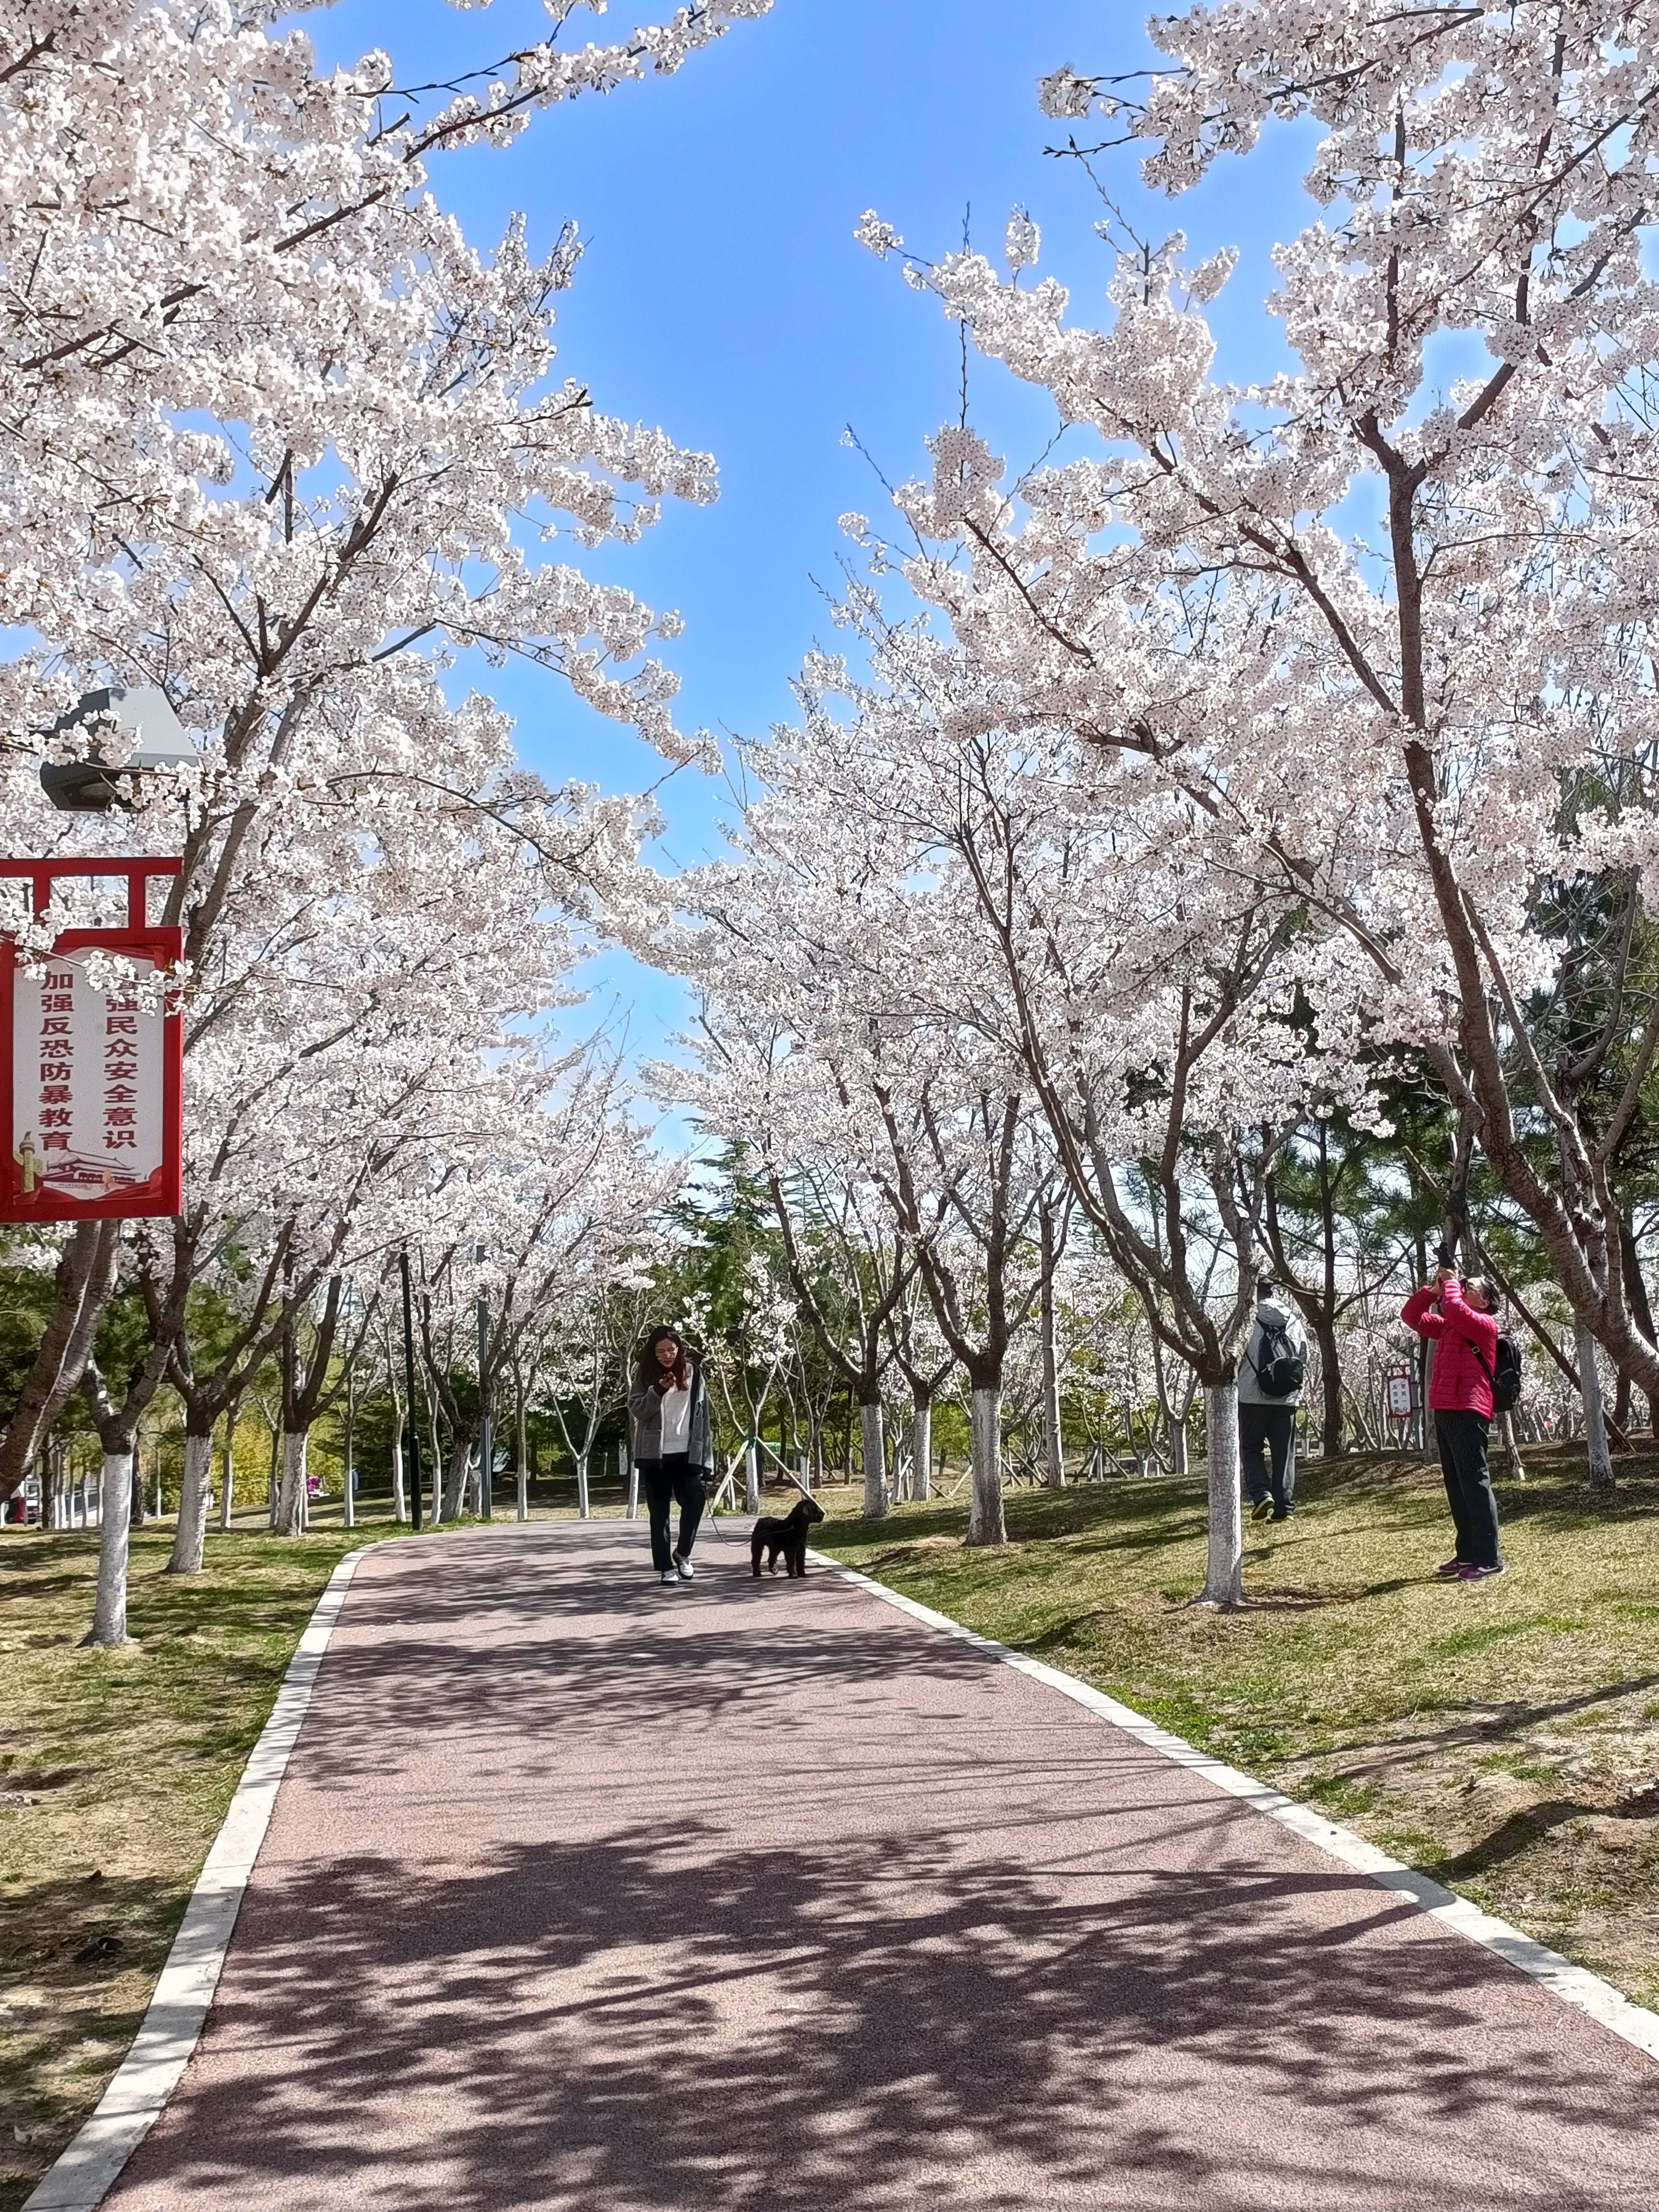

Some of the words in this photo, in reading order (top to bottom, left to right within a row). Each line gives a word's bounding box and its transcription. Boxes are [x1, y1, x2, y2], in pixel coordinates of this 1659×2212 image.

[39, 971, 75, 1150] 加强反恐防暴教育
